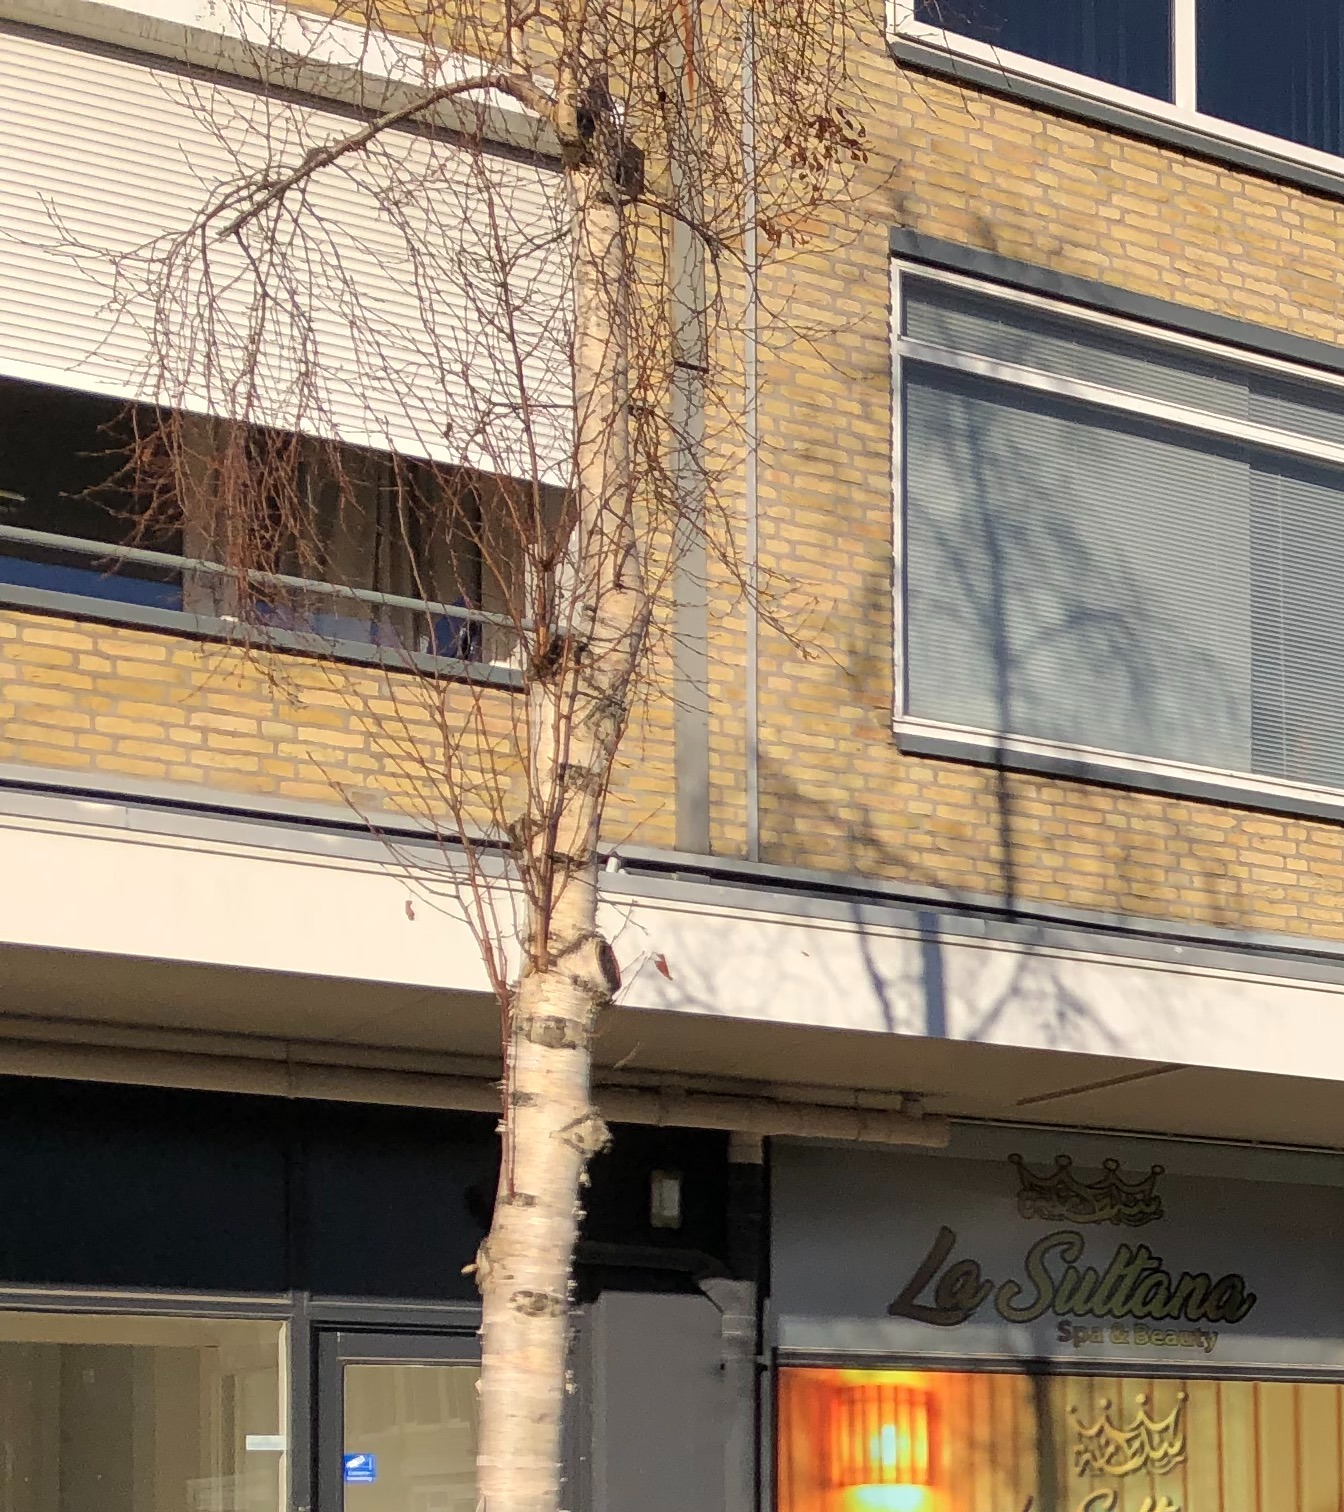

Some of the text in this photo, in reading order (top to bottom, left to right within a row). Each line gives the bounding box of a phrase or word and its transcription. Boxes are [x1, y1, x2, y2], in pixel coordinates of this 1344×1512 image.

[888, 1226, 1257, 1327] La Sultana
[1056, 1321, 1219, 1354] Spa & Beauty
